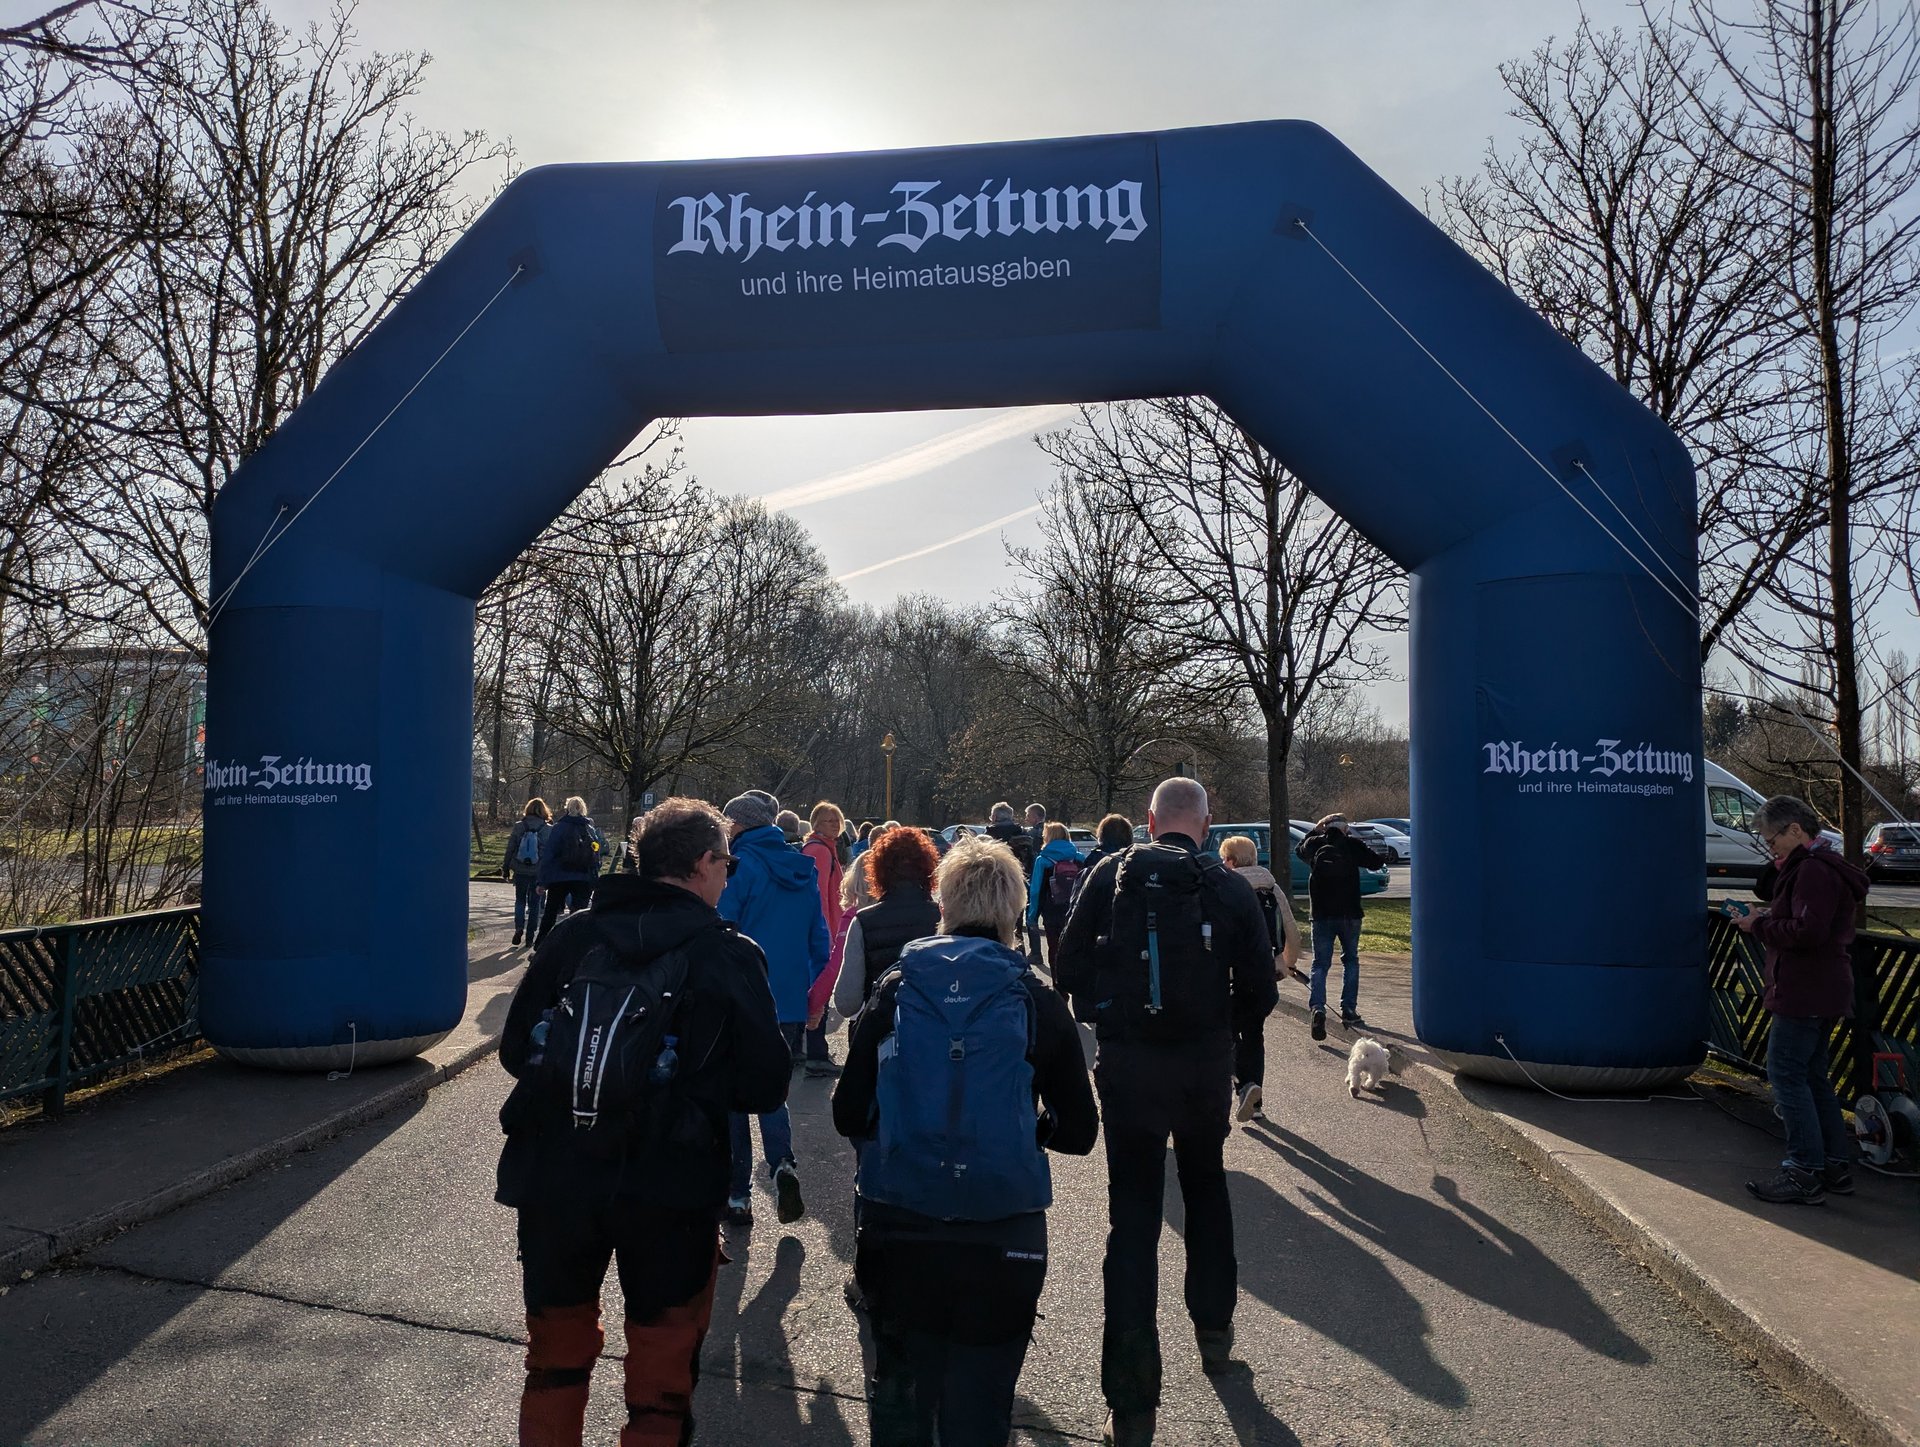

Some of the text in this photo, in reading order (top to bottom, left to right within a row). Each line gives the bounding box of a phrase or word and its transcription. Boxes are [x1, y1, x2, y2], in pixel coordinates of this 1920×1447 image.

[666, 177, 1148, 263] Rhein-Zeitung
[740, 258, 1071, 296] und ihre Heimatausgaben
[1482, 738, 1694, 783] Rhein-Zeitung
[215, 793, 338, 805] und ihre Heimatausgaben
[1518, 781, 1674, 796] und ihre Heimatausgaben
[943, 995, 971, 1003] deuter
[582, 1026, 602, 1089] TOPTREK
